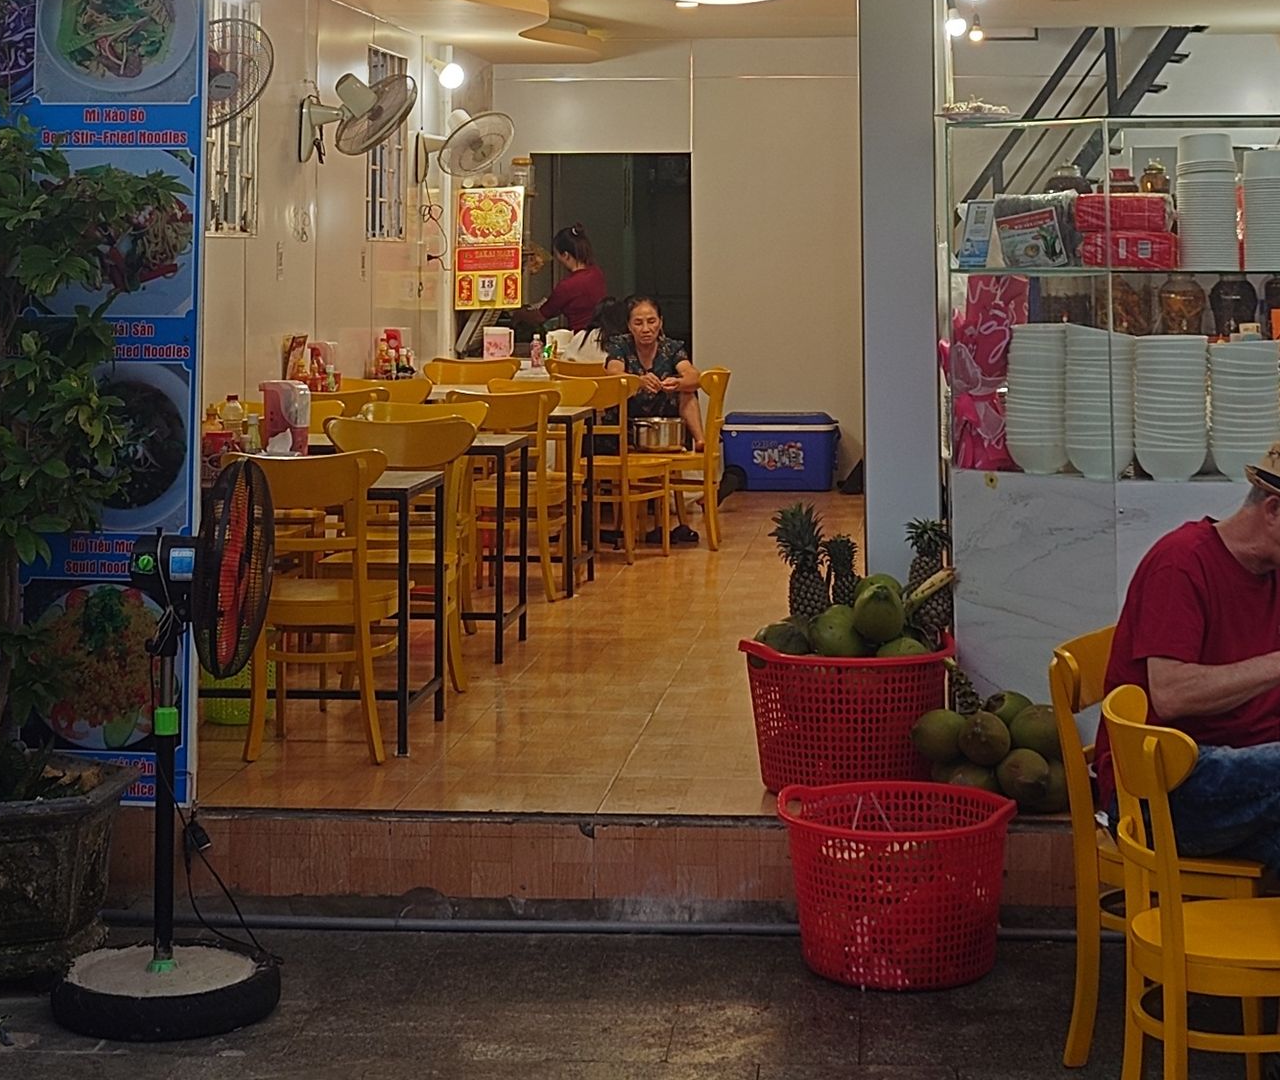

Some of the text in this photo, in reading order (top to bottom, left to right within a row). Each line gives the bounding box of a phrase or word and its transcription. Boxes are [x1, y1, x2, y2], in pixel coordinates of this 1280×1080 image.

[83, 108, 100, 123] Mì
[42, 131, 70, 145] Bef
[137, 131, 187, 145] Noodles
[480, 280, 494, 289] 13
[131, 320, 154, 337] Sản
[143, 345, 190, 359] Noodles
[64, 560, 97, 575] Squid
